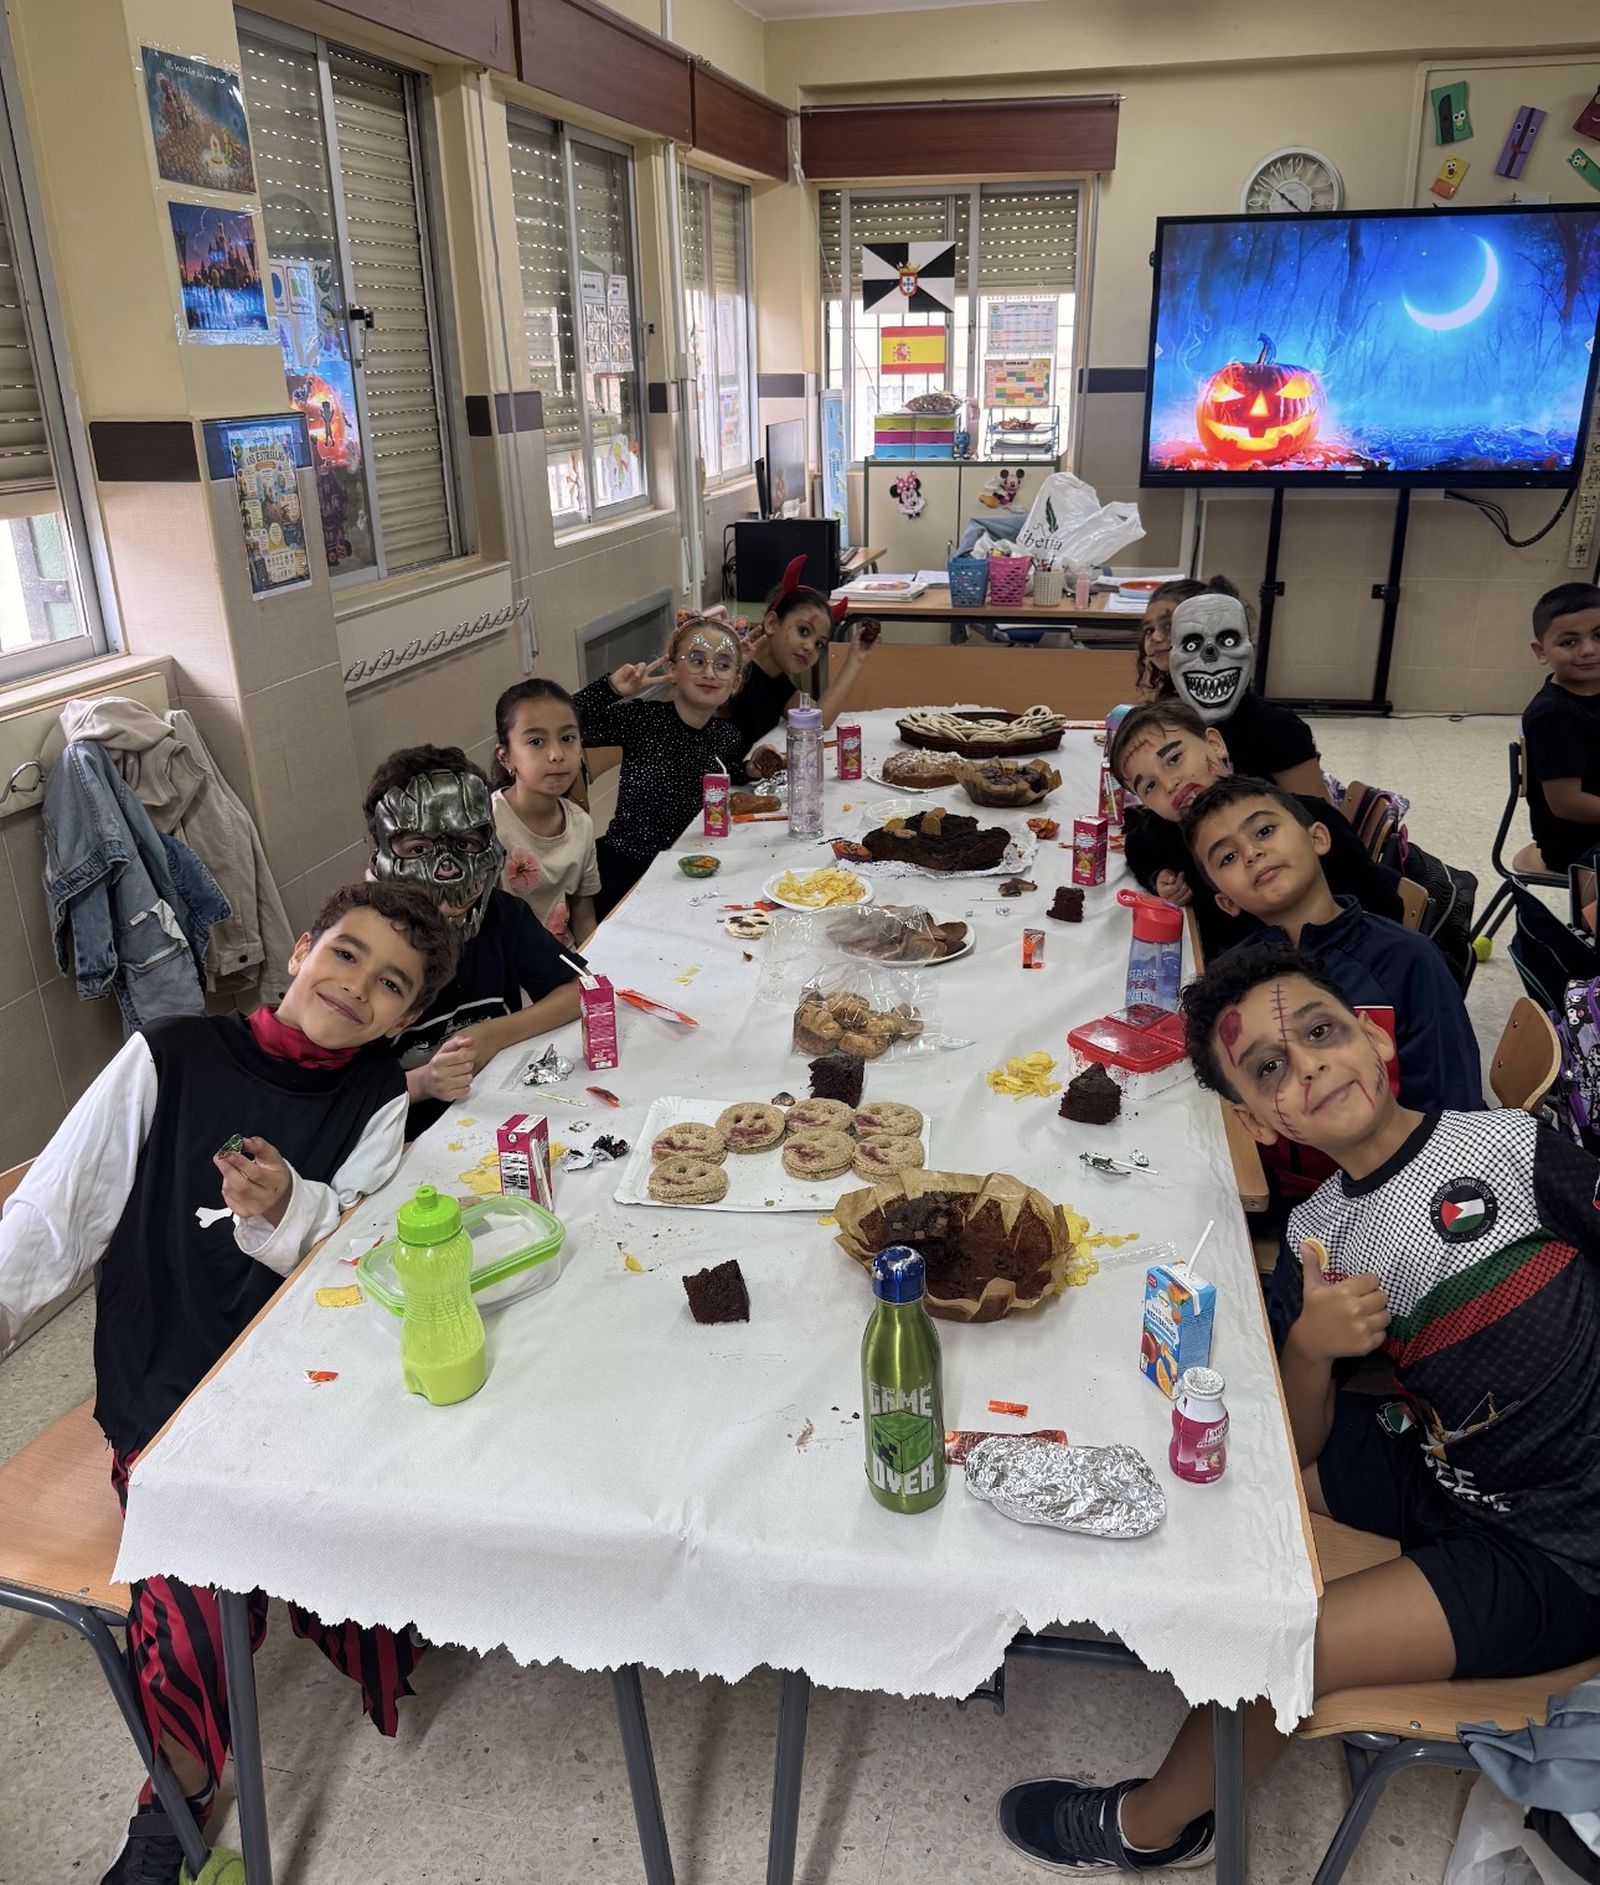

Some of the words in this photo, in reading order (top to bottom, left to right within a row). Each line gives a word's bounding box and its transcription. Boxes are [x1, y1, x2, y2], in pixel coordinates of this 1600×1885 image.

[256, 450, 284, 462] ESTRELLAS
[869, 1380, 934, 1418] GAME
[872, 1452, 935, 1494] OVER
